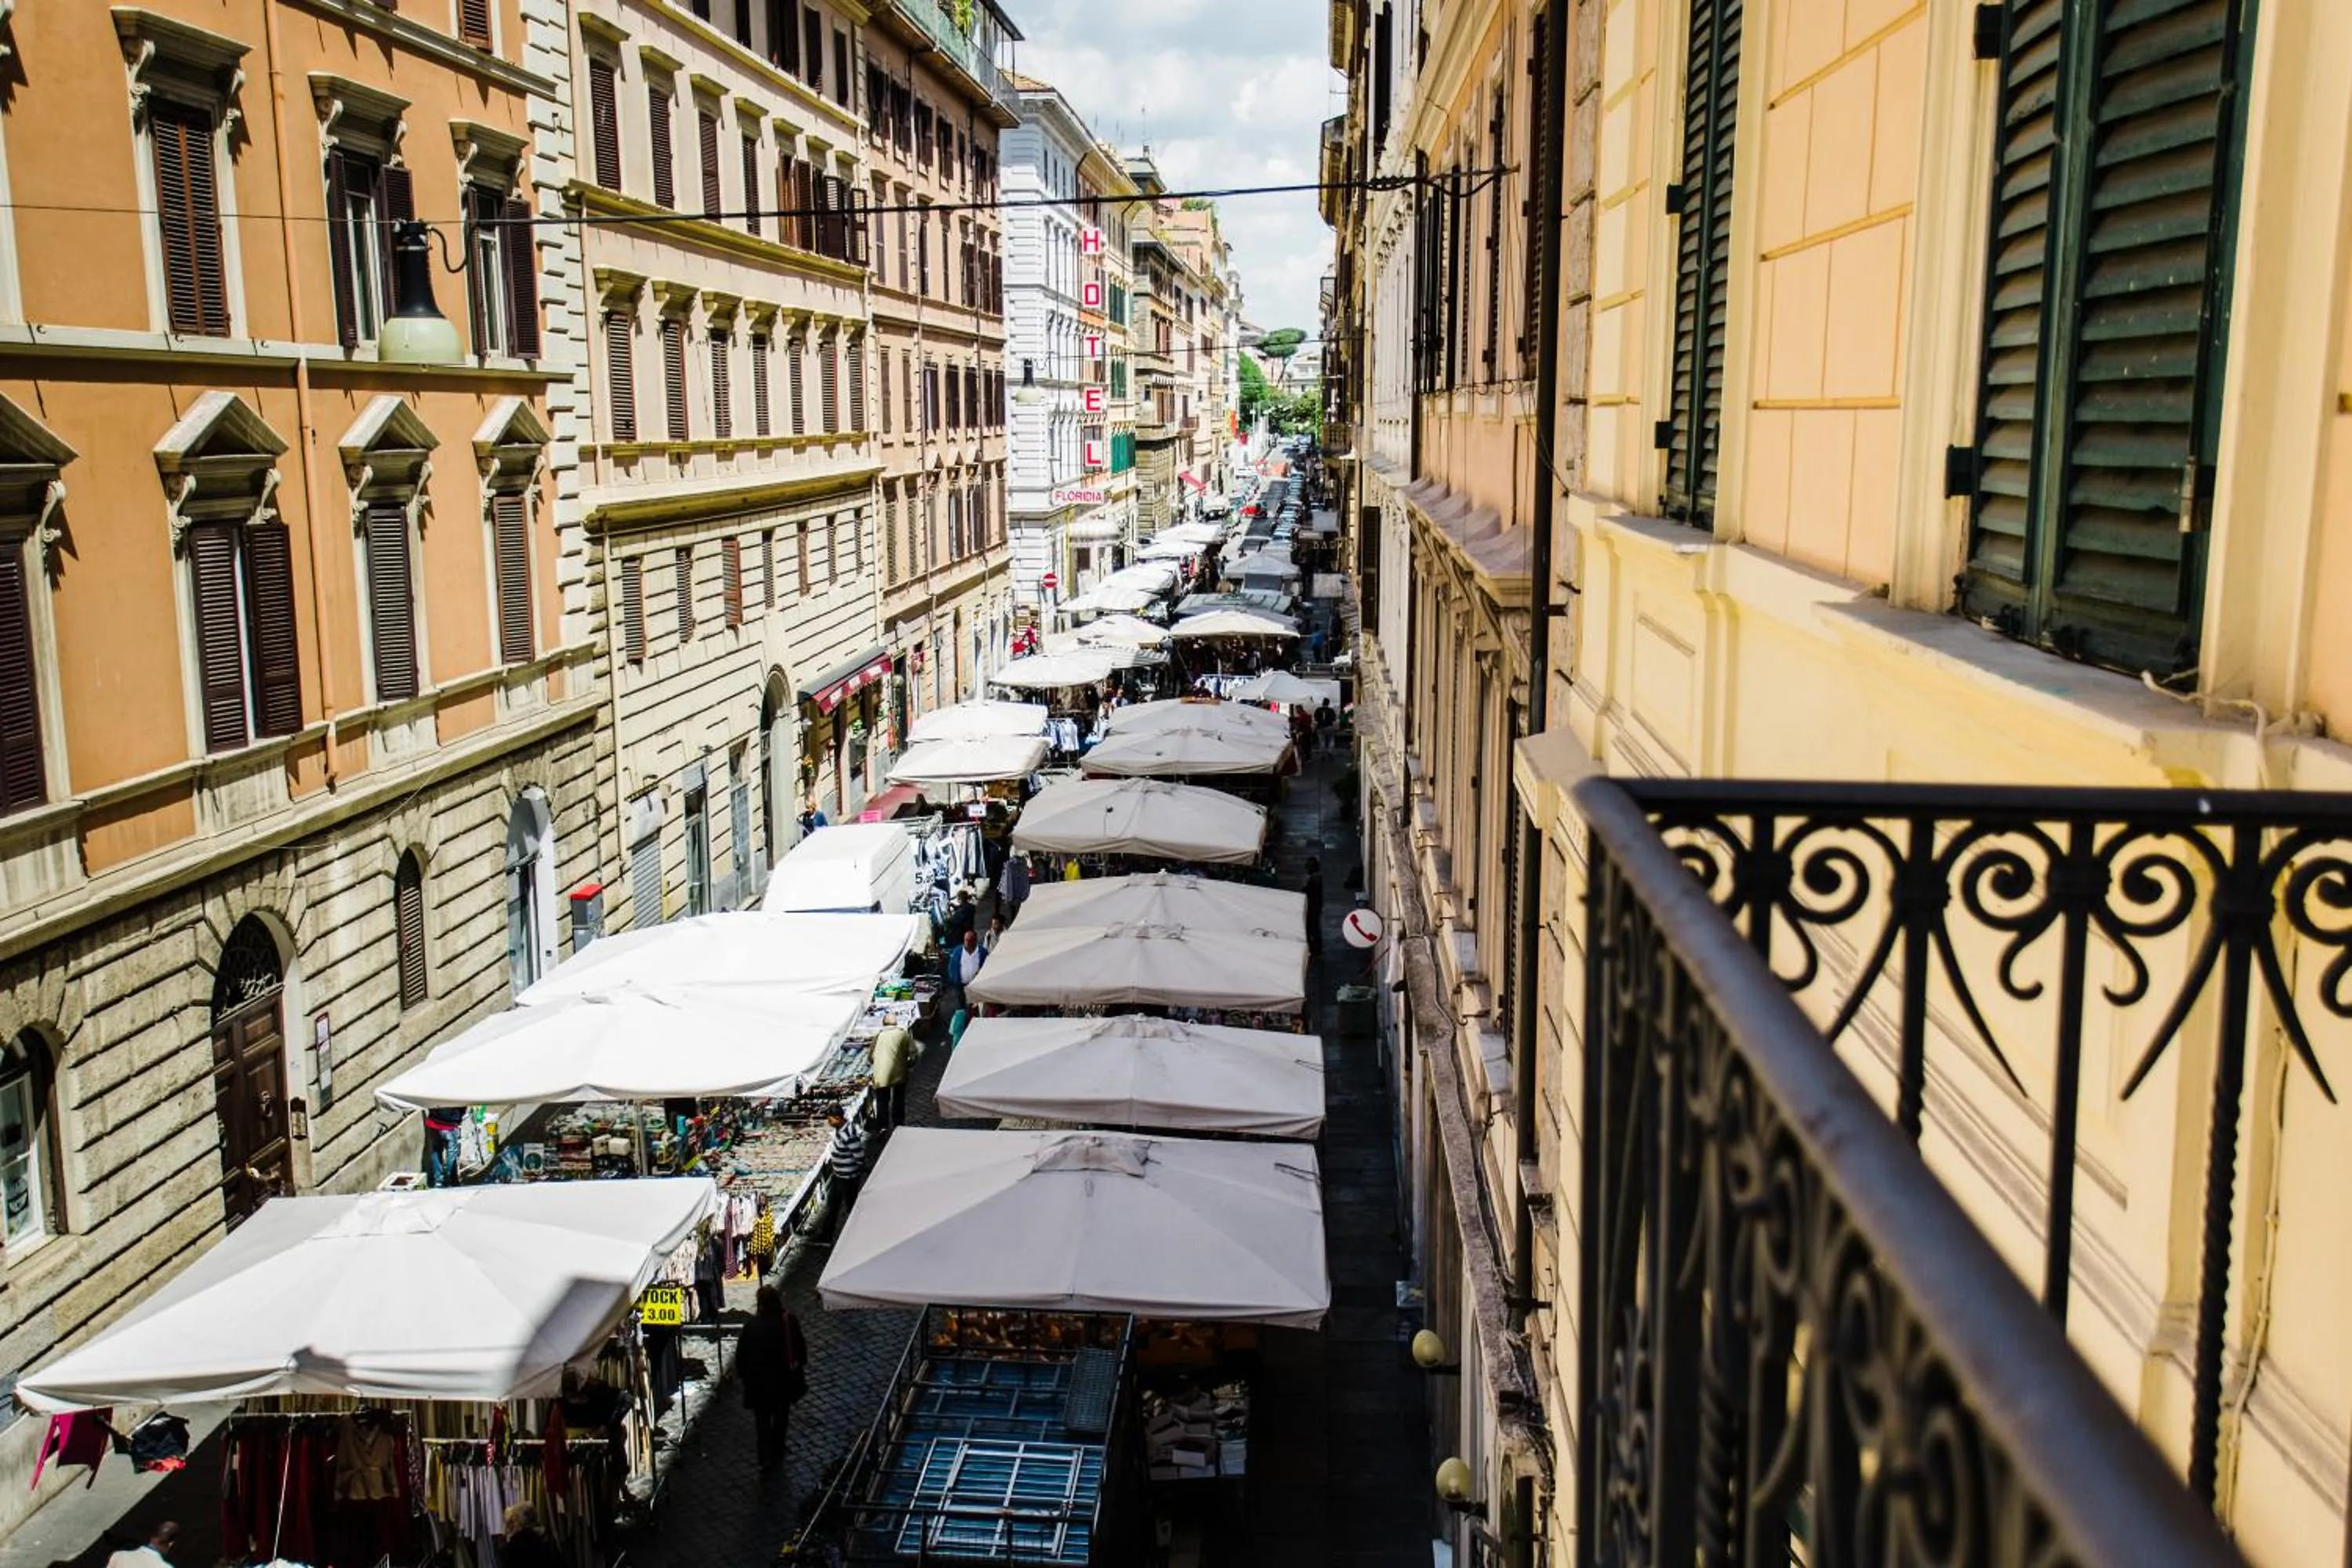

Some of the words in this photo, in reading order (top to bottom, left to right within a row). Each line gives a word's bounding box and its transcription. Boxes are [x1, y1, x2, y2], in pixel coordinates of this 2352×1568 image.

[1083, 230, 1102, 464] HOTEL
[1055, 490, 1102, 502] FLORIDIA
[637, 1290, 678, 1305] TOCK
[648, 1308, 675, 1321] 3.00
